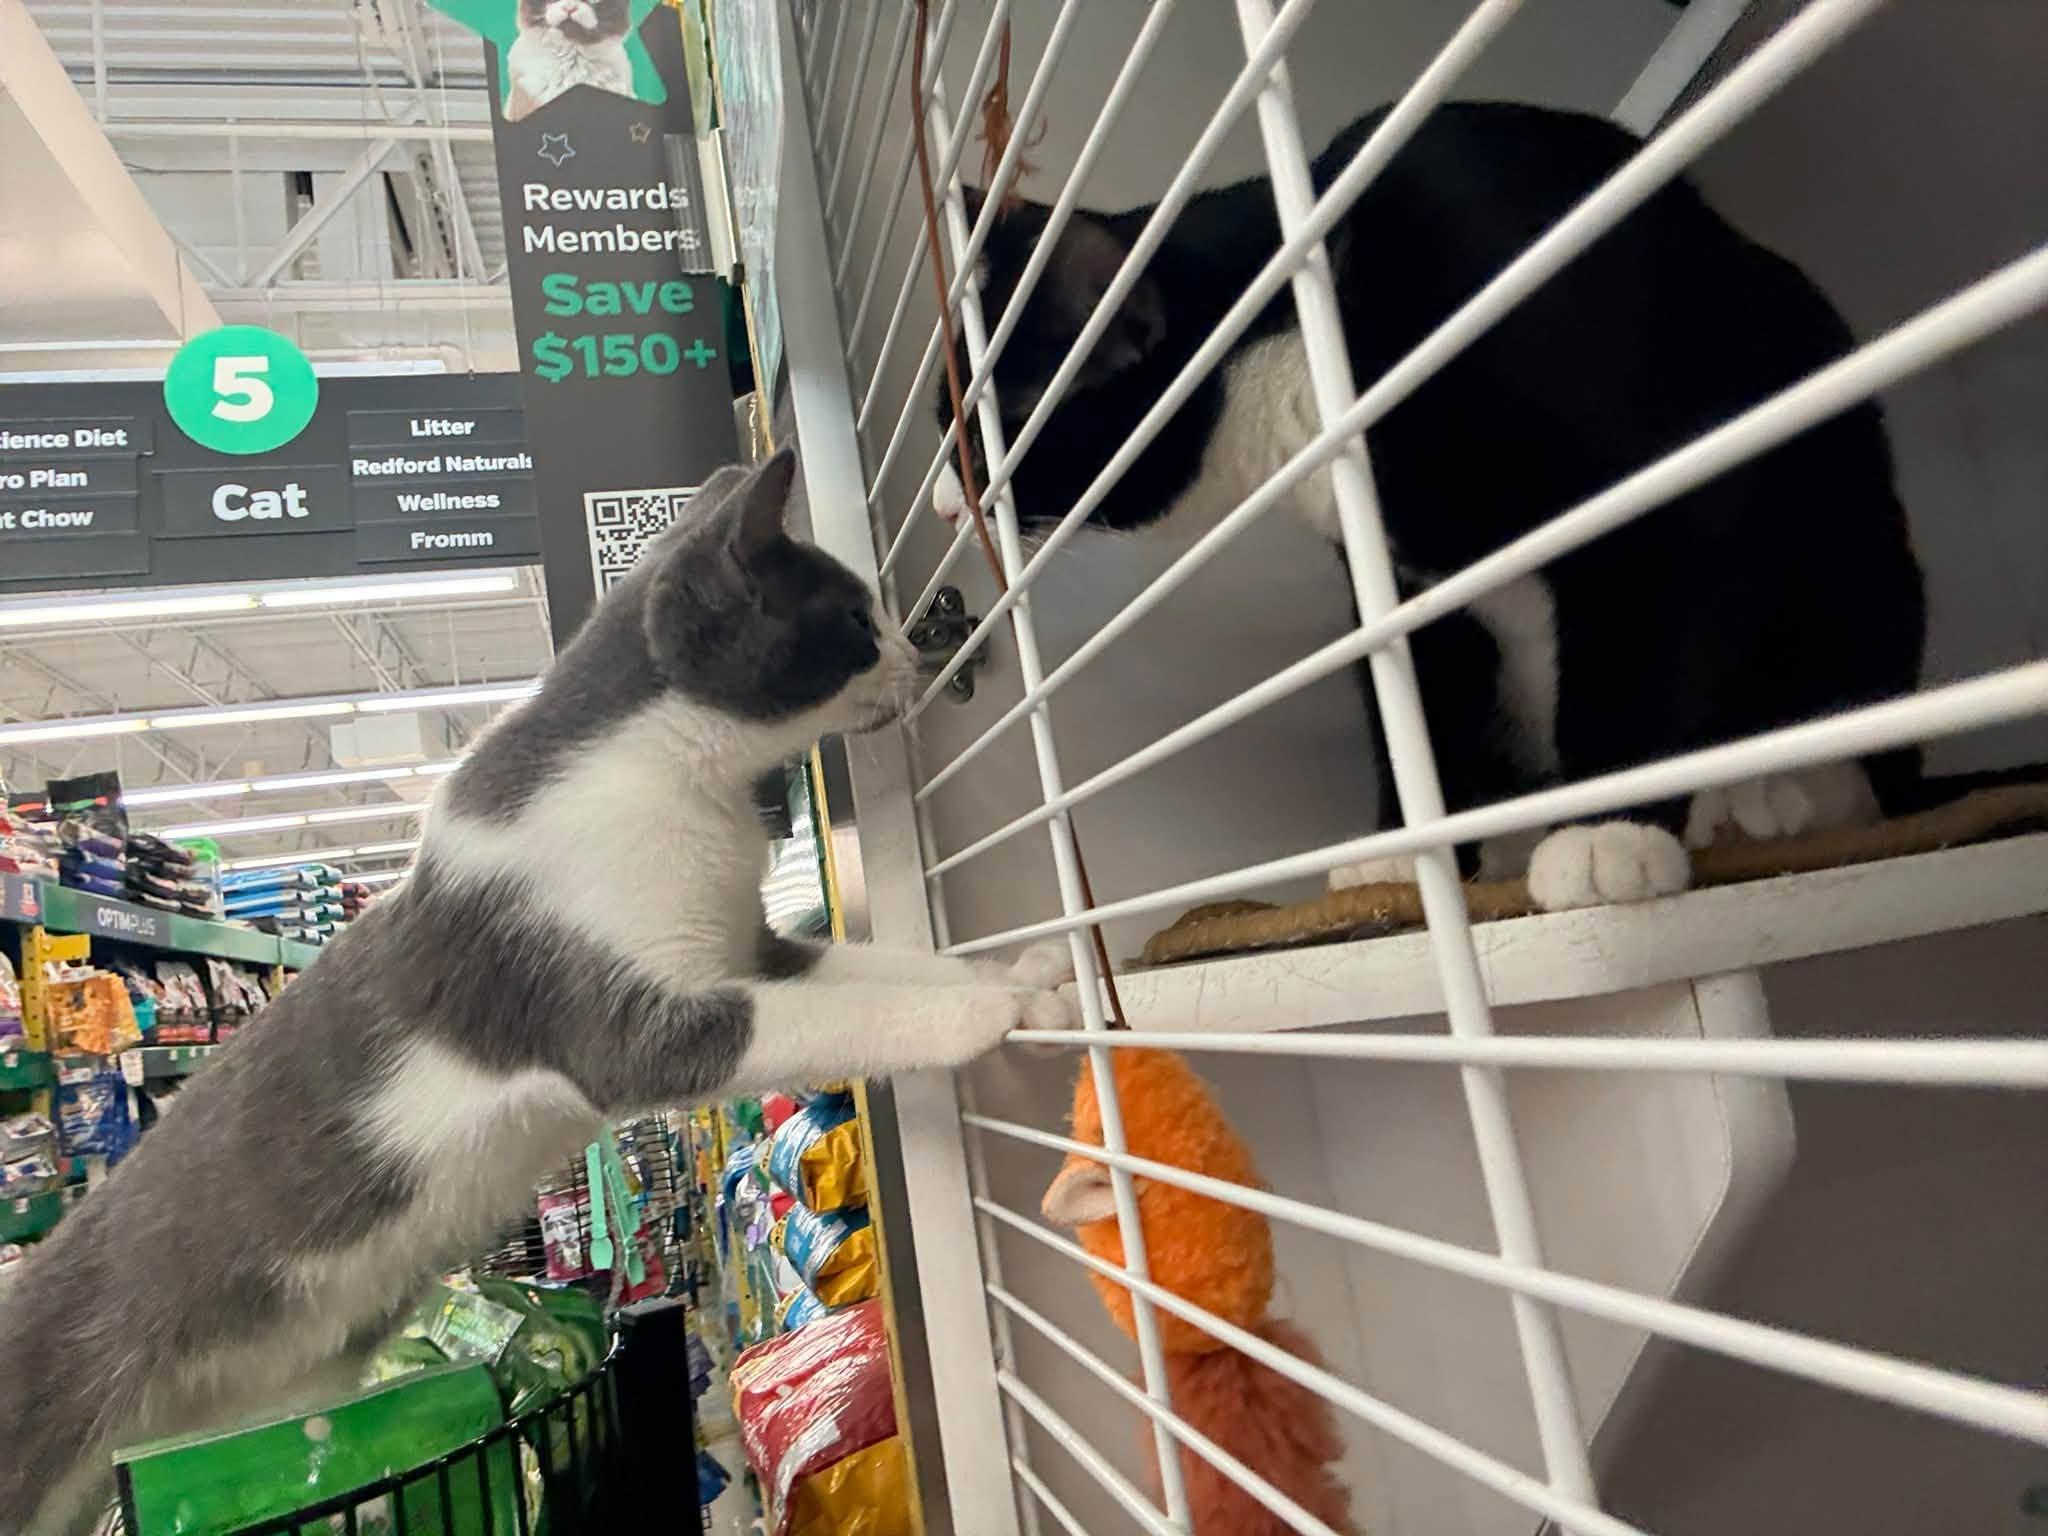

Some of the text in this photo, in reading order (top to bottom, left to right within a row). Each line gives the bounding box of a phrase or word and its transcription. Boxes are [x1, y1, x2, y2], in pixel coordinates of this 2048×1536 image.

[523, 182, 689, 211] Rewards
[523, 223, 700, 253] Members
[541, 273, 695, 316] Save
[532, 330, 716, 383] $150+
[211, 355, 275, 422] 5
[0, 428, 128, 449] ience Diet
[410, 419, 475, 437] Litter
[352, 457, 441, 475] Redford
[30, 469, 88, 488] Plan
[212, 483, 309, 521] Cat
[397, 493, 500, 512] Wellness
[0, 509, 94, 529] t Chow
[411, 532, 493, 549] Fromm
